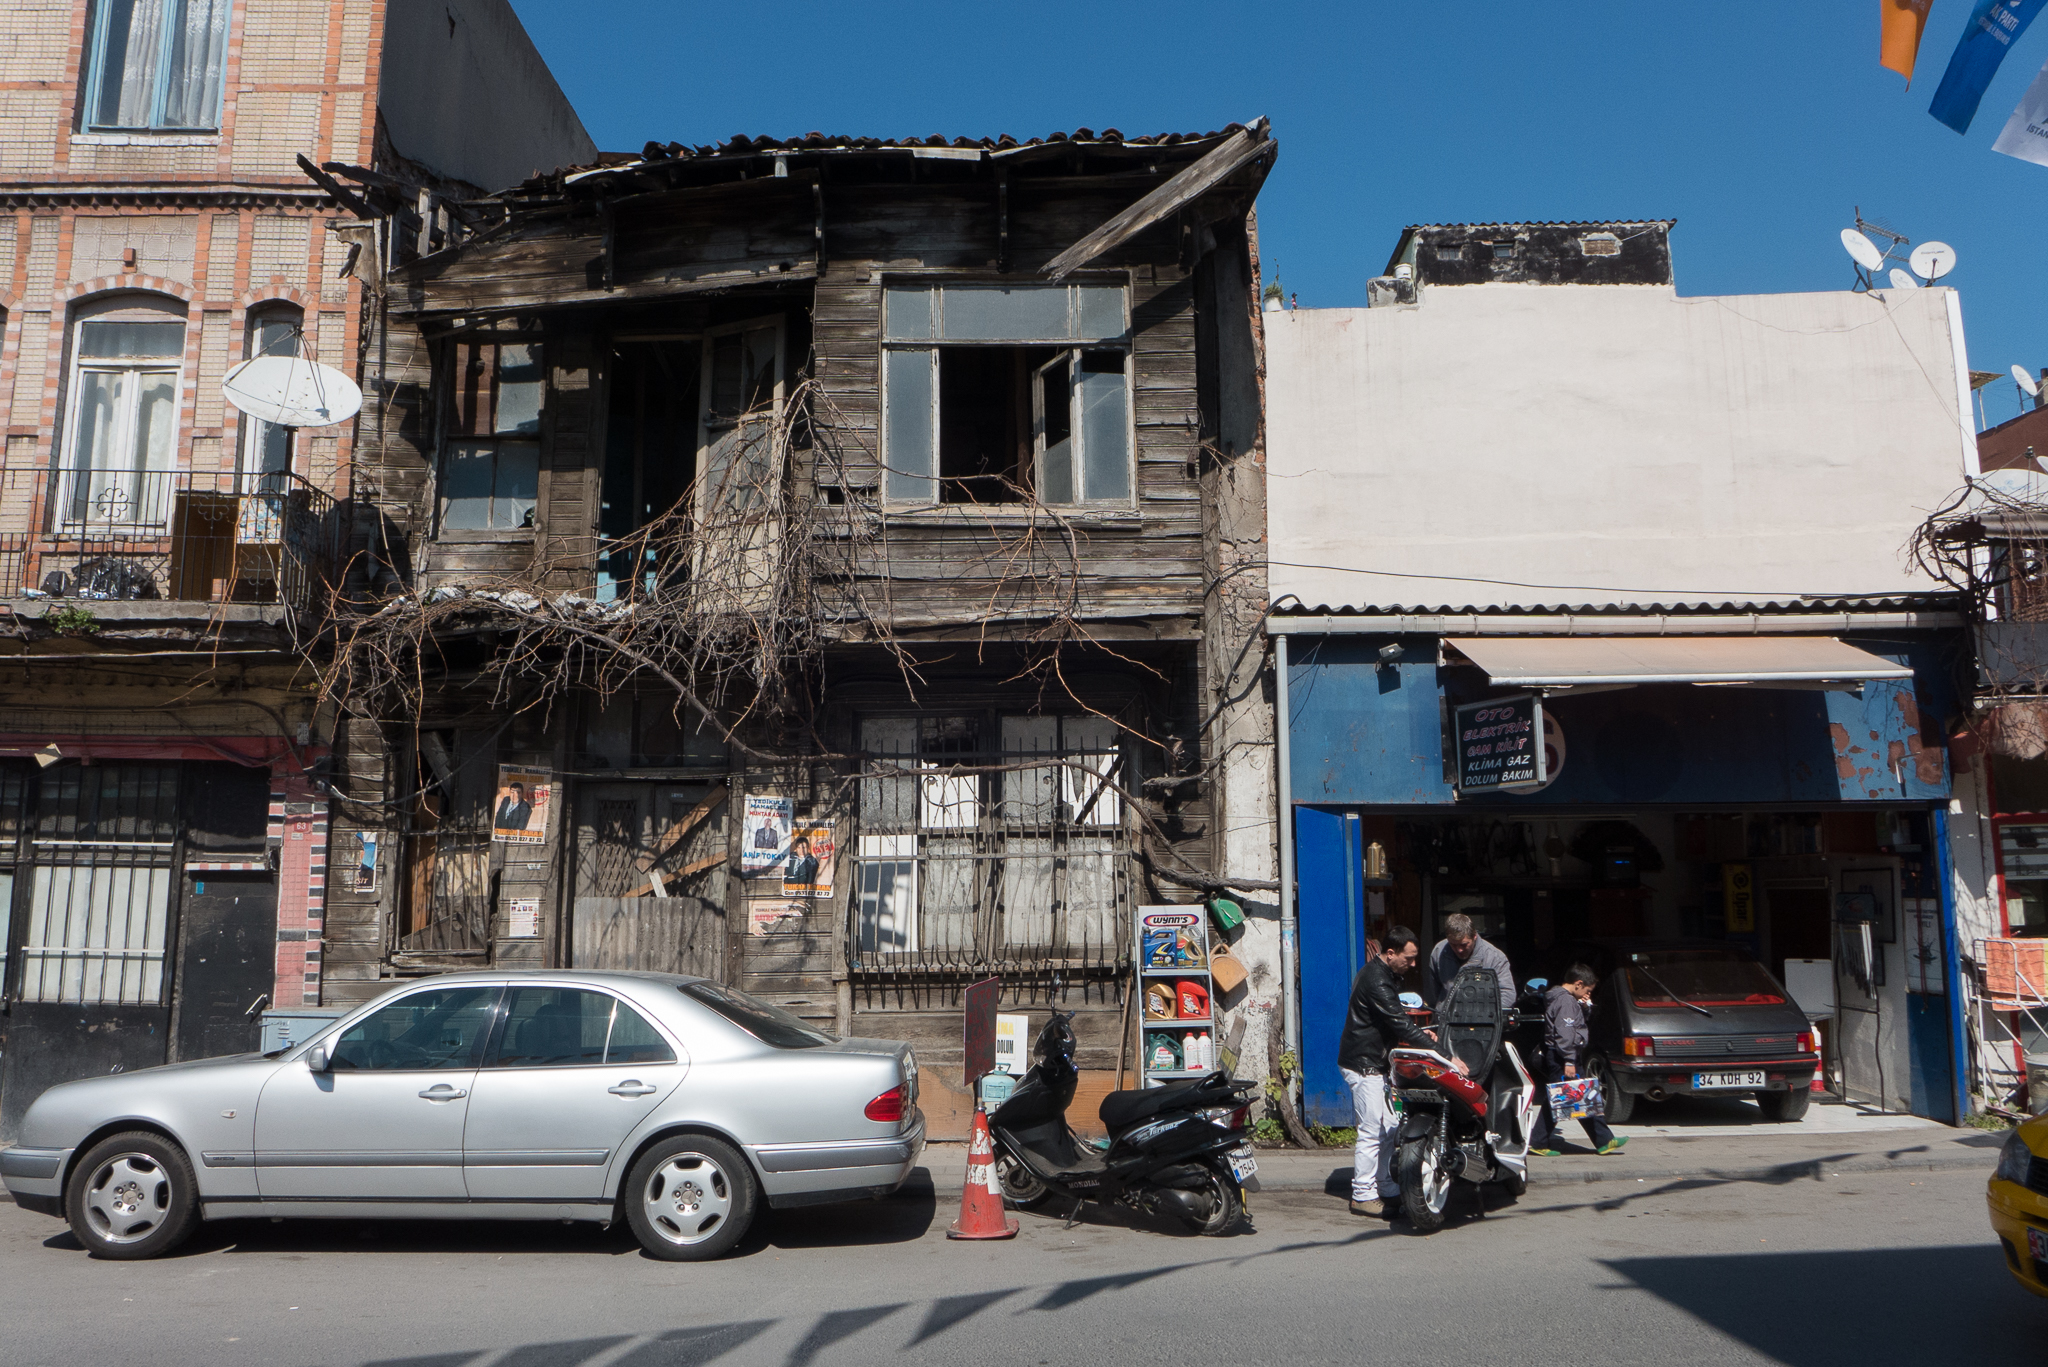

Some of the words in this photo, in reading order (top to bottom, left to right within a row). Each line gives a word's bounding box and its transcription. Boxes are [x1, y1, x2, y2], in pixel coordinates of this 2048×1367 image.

[1475, 706, 1515, 722] OTO
[1463, 717, 1531, 741] ELEKTRİK
[1495, 736, 1527, 753] KİLİT
[1468, 758, 1502, 772] KLİMA
[1506, 754, 1531, 767] GAZ
[1465, 774, 1498, 786] DOLUM
[1502, 769, 1533, 782] BAKIM
[296, 822, 306, 830] 63
[743, 851, 760, 859] ARİF
[997, 1039, 1014, 1054] DOLUM
[1699, 1074, 1713, 1086] 34
[1720, 1073, 1741, 1085] KDH
[1748, 1072, 1762, 1084] 92
[1067, 1179, 1101, 1189] MONDIAL
